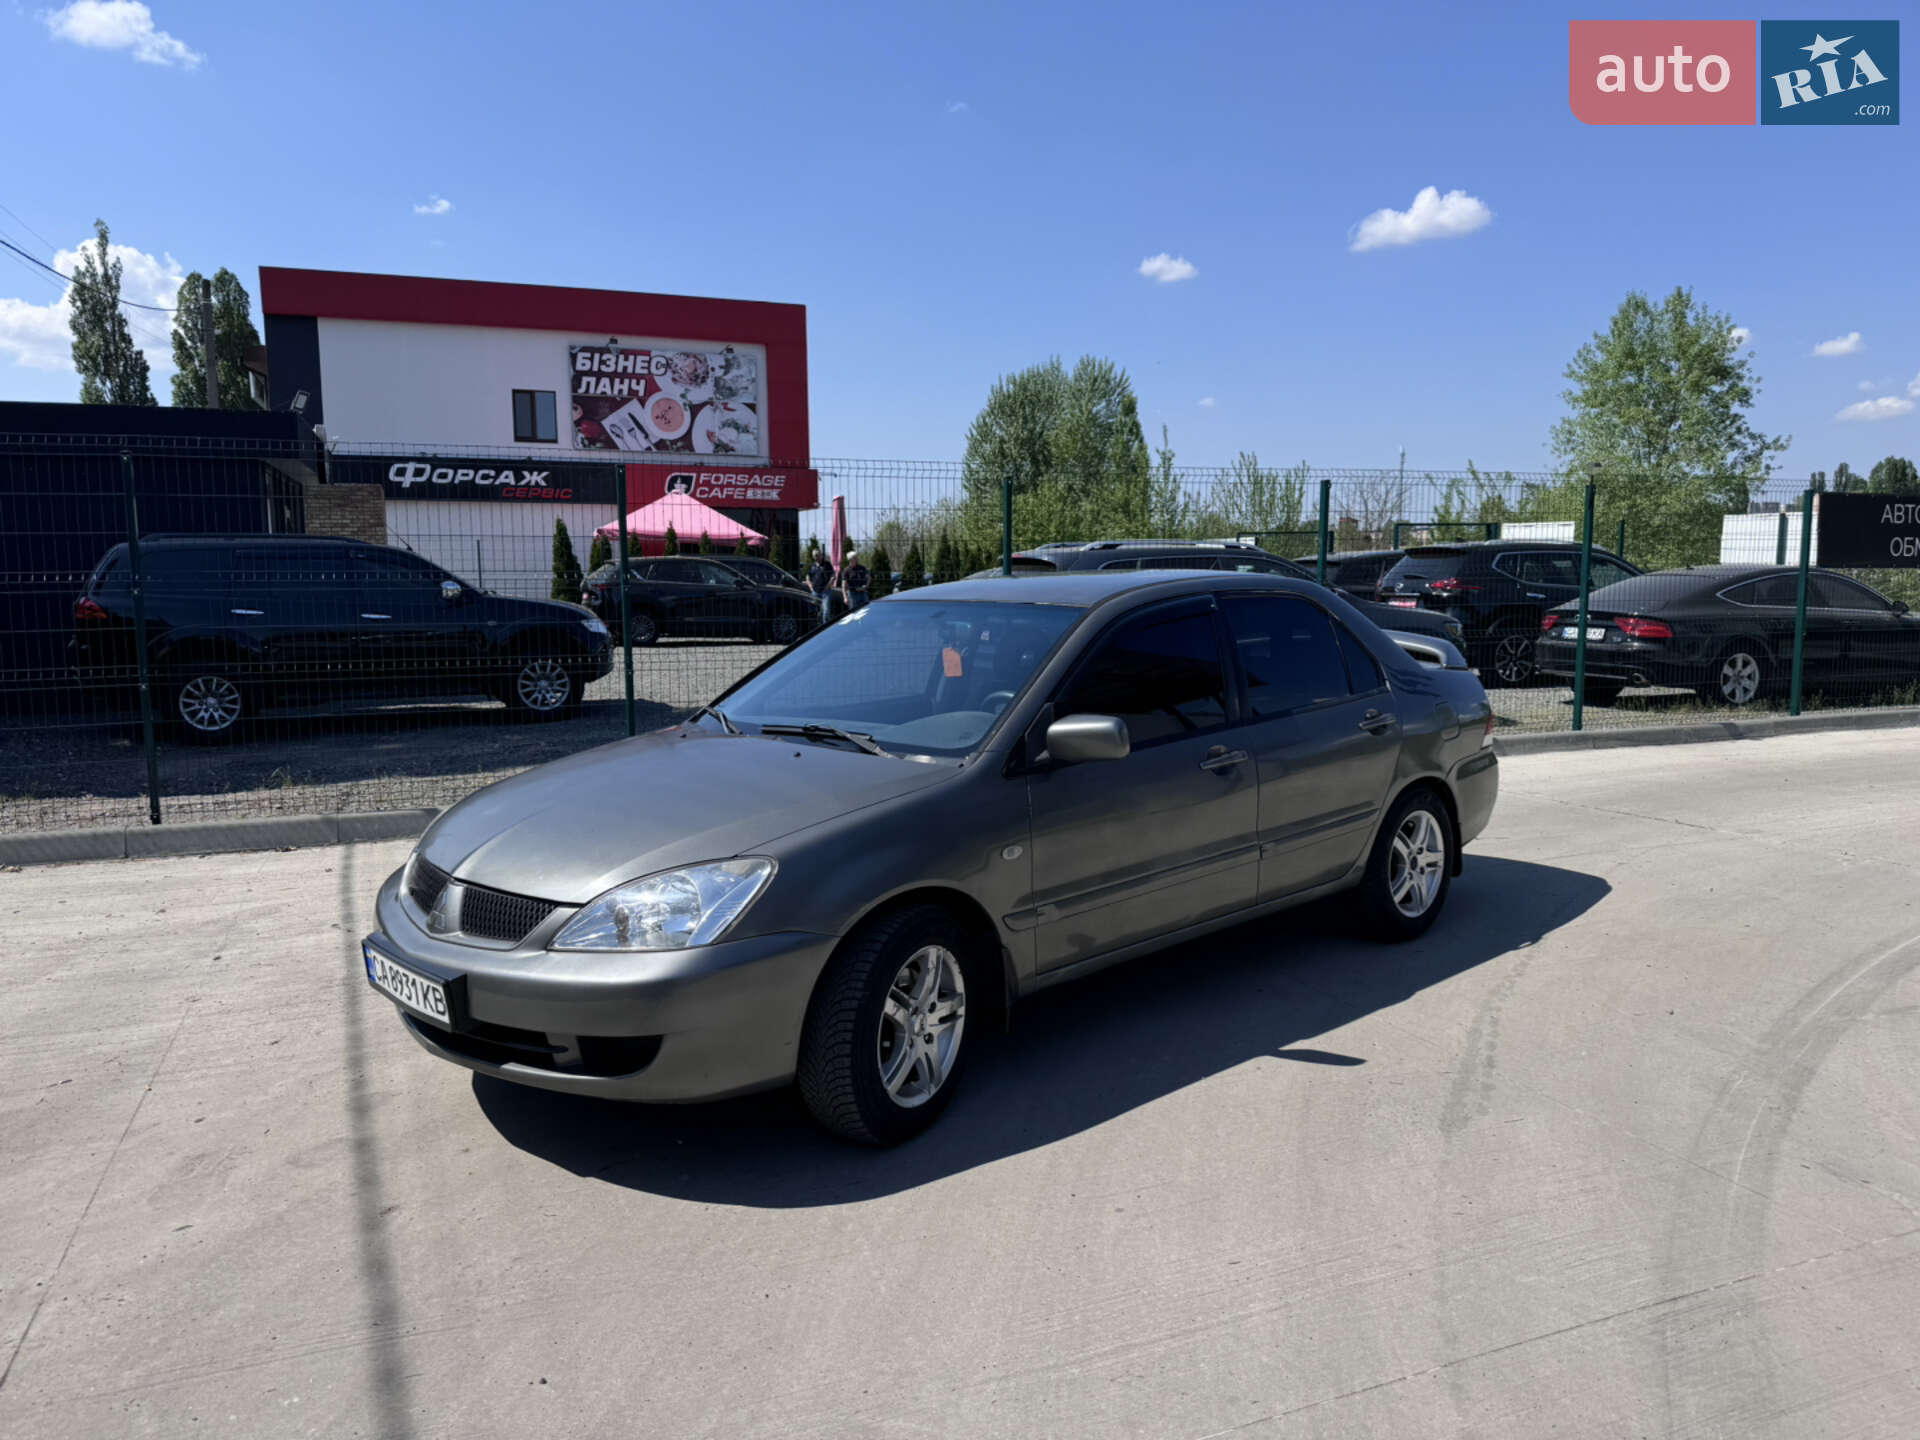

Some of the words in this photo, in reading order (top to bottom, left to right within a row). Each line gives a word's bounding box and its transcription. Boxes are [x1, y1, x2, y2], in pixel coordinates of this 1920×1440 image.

[575, 352, 668, 376] БІЗНЕС
[577, 376, 647, 397] ЛАНЧ
[388, 461, 550, 488] ФОРСАЖ
[700, 472, 786, 487] FORSAGE
[502, 487, 574, 499] СЕРВІС
[695, 487, 746, 499] CAFE
